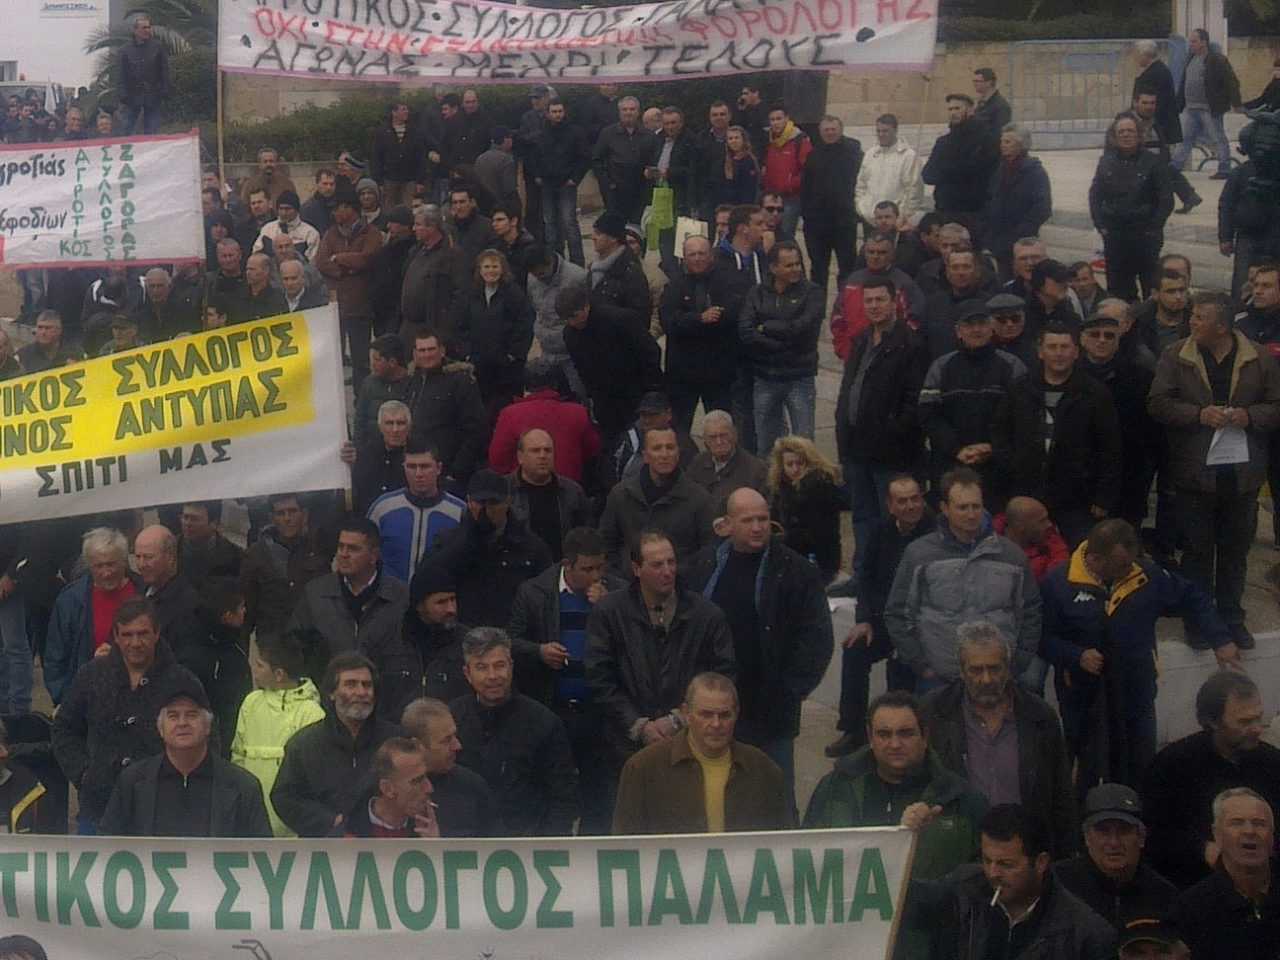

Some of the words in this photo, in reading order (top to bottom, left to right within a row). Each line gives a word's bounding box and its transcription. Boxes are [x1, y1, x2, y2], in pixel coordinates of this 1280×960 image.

[253, 7, 308, 40] ΟΧΙ
[253, 42, 429, 77] ΑΓΩΝΑΣ
[111, 321, 299, 396] ΣΥΛΛΟΓΟΣ
[114, 367, 288, 440] ΑΝΤΥΠΑΣ
[35, 455, 127, 498] ΣΠΙΤΙ
[159, 438, 232, 475] ΜΑΣ
[212, 848, 574, 931] ΣΥΛΛΟΓΟΣ
[595, 847, 894, 928] ΠΑΛΑΜΑ
